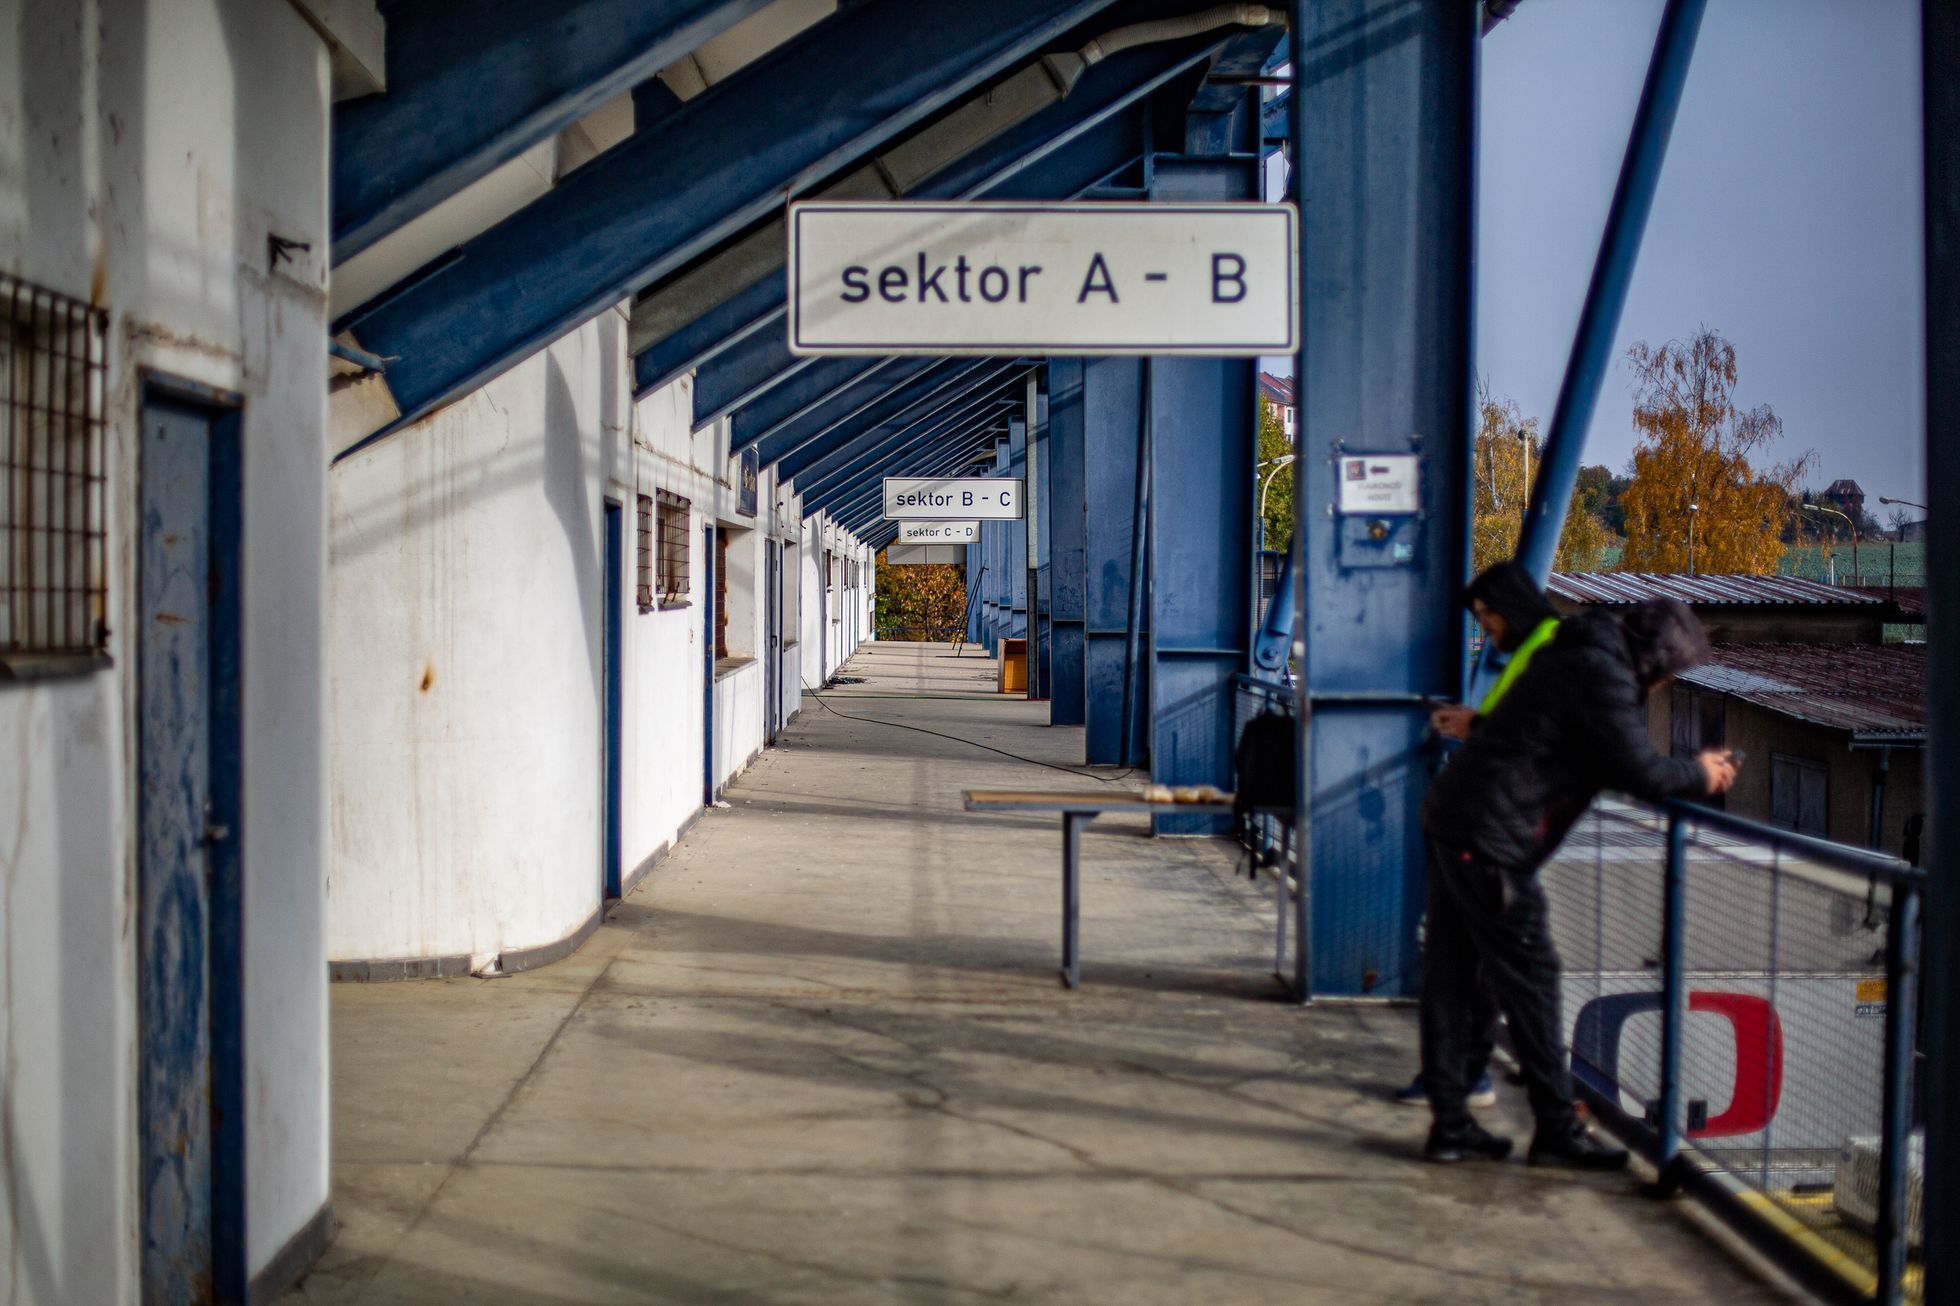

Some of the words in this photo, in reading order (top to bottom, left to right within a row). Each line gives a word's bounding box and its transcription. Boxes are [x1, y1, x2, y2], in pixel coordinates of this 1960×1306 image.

[839, 250, 1043, 304] sektor
[1077, 252, 1120, 304] A
[1211, 252, 1248, 304] B
[896, 491, 954, 507] sektor
[962, 491, 974, 507] B
[999, 491, 1011, 507] C
[906, 527, 940, 537] sektor
[944, 527, 952, 537] C
[965, 527, 974, 537] D
